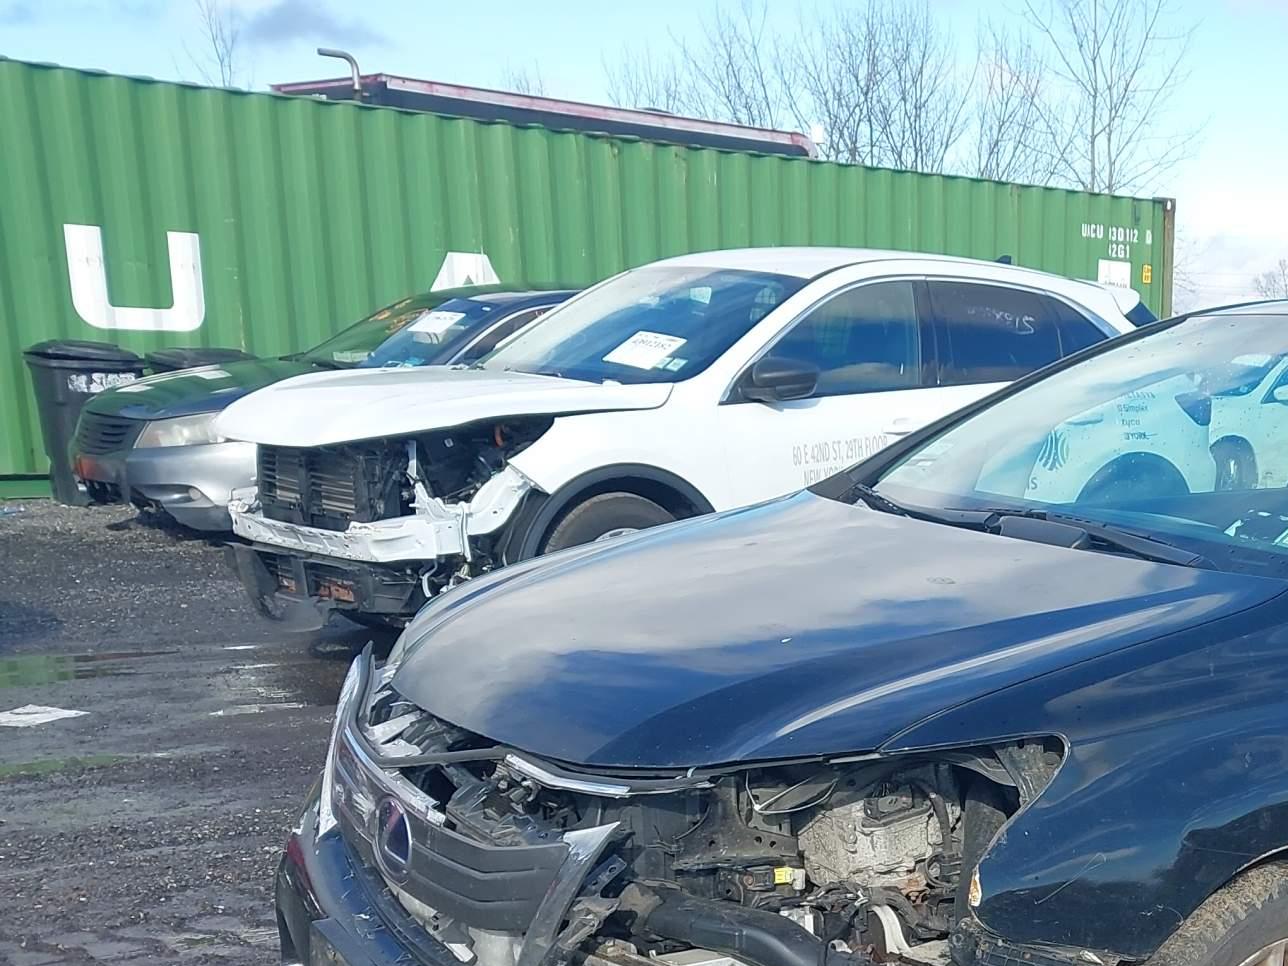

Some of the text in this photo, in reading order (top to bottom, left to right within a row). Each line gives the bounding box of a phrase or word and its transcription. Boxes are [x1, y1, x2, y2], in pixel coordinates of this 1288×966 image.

[63, 223, 205, 332] U
[792, 445, 802, 466] 60
[804, 444, 809, 464] E
[811, 442, 830, 464] 42ND
[845, 438, 864, 460] 29TH
